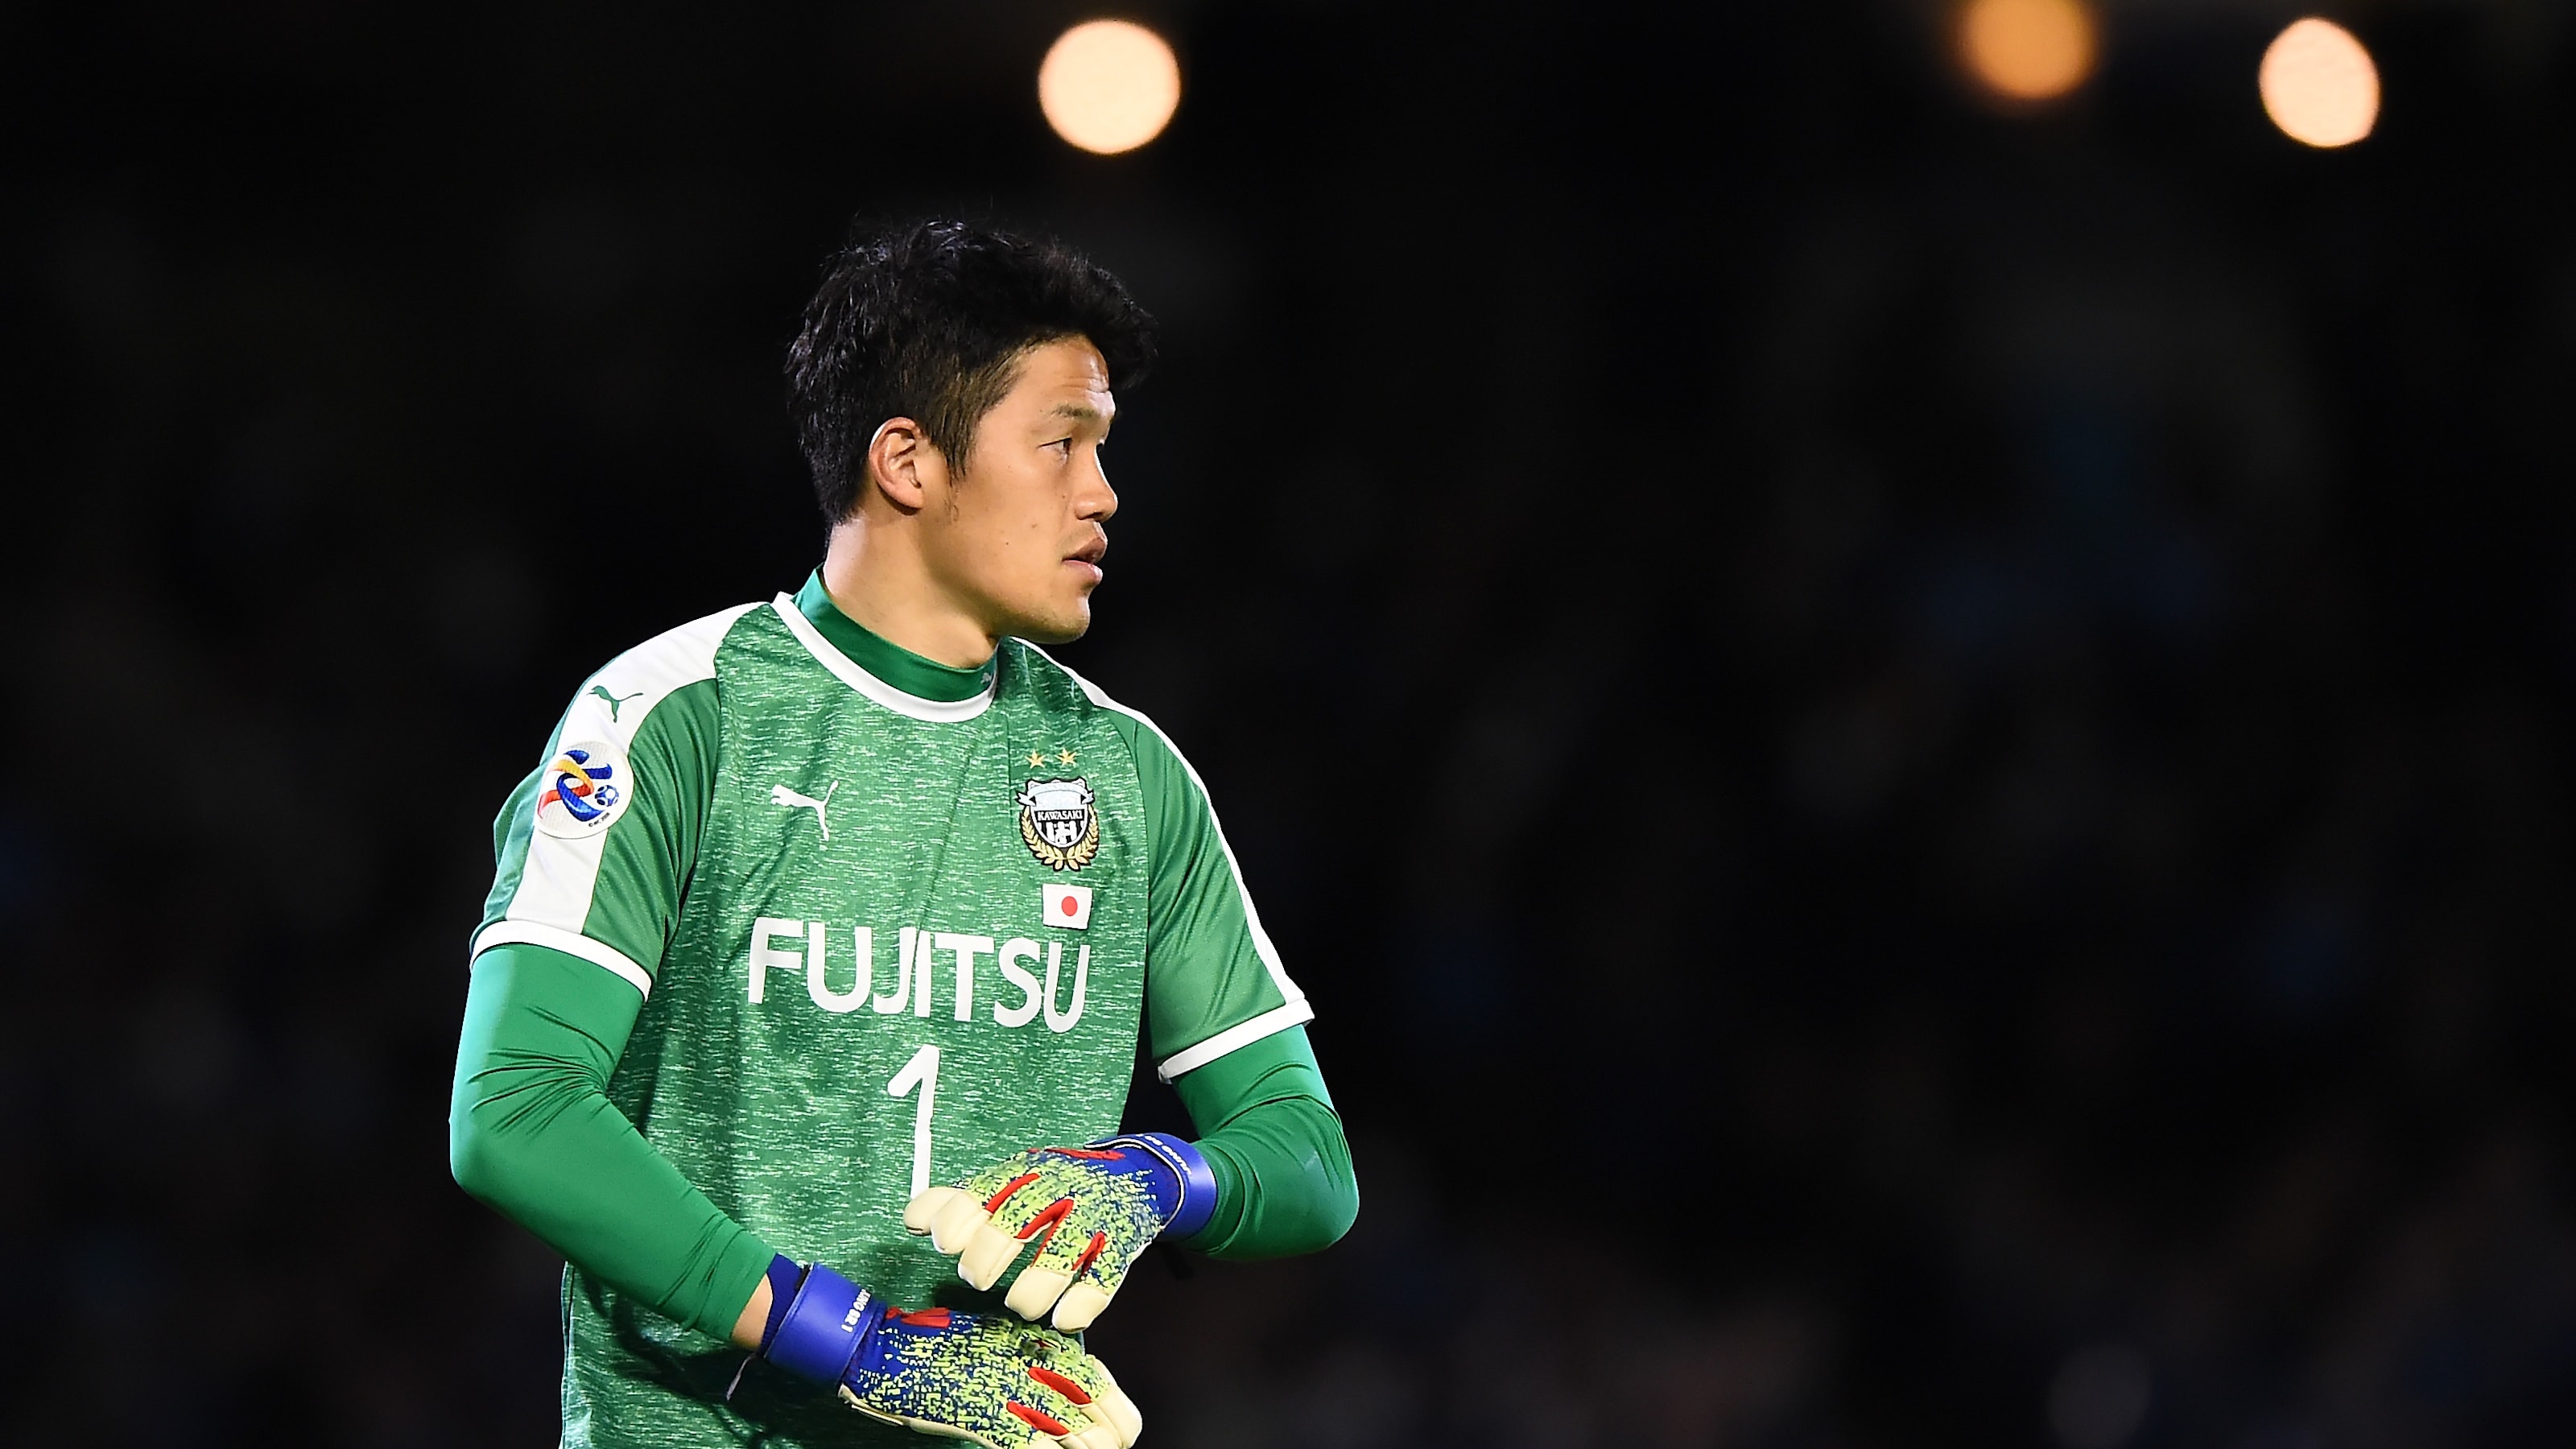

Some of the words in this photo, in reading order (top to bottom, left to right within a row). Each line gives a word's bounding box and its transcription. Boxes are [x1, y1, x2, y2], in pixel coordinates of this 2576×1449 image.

[1037, 810, 1083, 821] KAWASAKI
[748, 916, 1091, 1033] FUJITSU
[887, 1043, 939, 1199] 1
